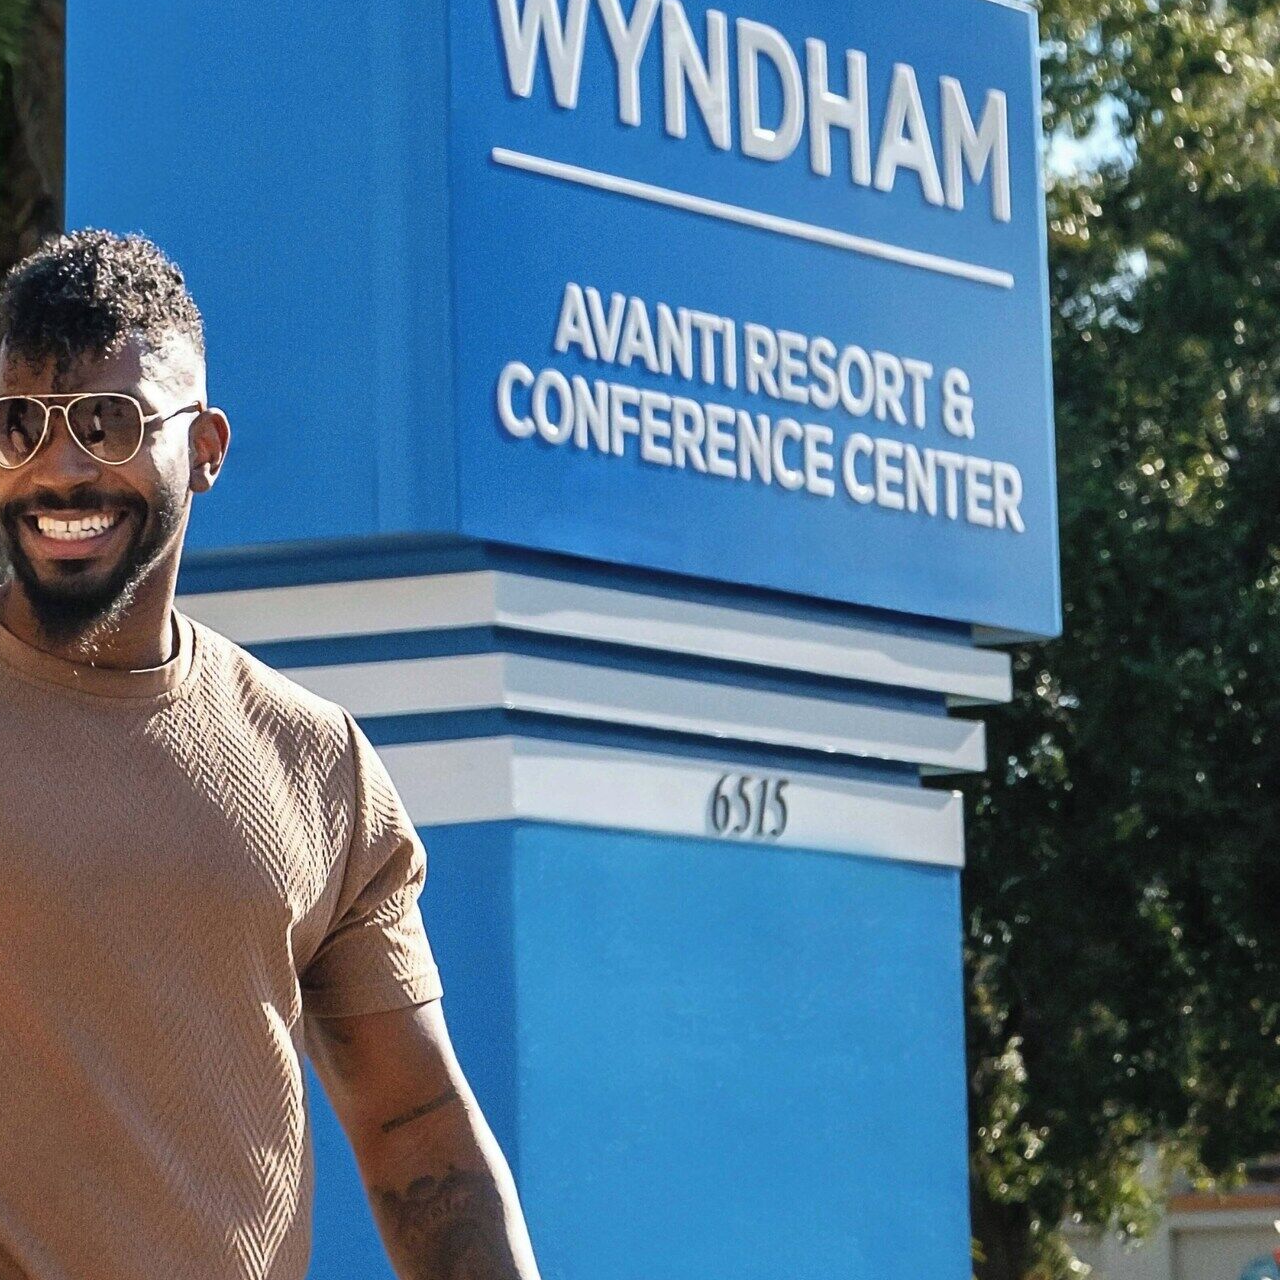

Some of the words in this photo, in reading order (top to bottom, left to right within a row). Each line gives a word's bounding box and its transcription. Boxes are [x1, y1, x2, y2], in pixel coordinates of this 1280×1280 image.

[555, 282, 737, 388] AVANTI
[746, 324, 934, 428] RESORT
[943, 367, 976, 439] &
[497, 363, 836, 499] CONFERENCE
[843, 433, 1026, 535] CENTER
[709, 773, 789, 839] 6515
